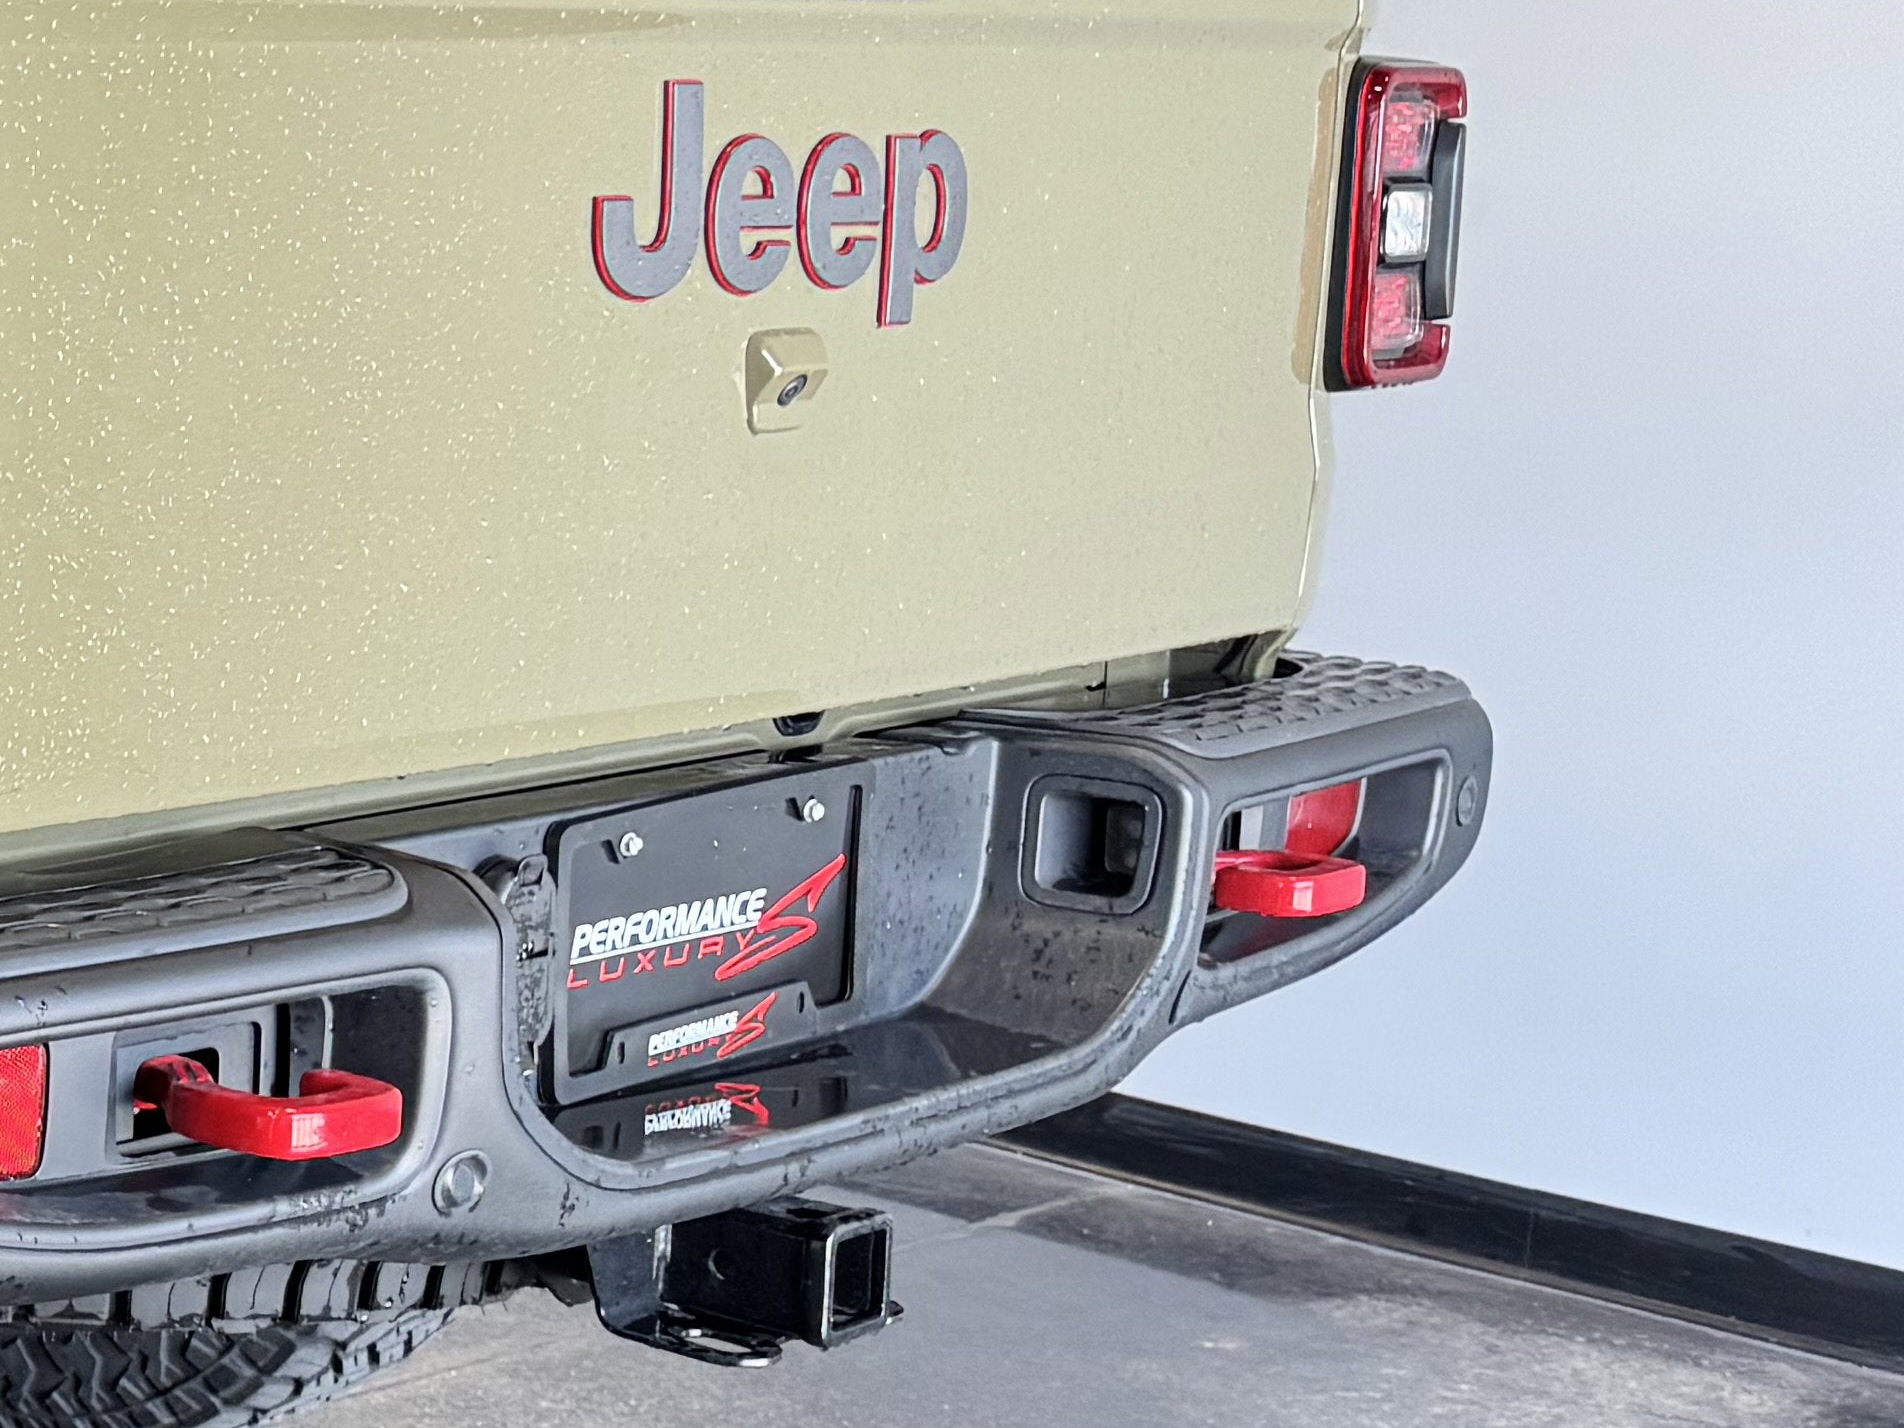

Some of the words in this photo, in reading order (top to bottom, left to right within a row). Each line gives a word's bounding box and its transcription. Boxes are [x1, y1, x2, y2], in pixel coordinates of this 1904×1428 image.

[592, 79, 968, 329] Jeep
[570, 888, 767, 960] PERFORMANCE
[566, 929, 756, 989] LUXURY
[648, 1011, 739, 1055] PERFORMANCE
